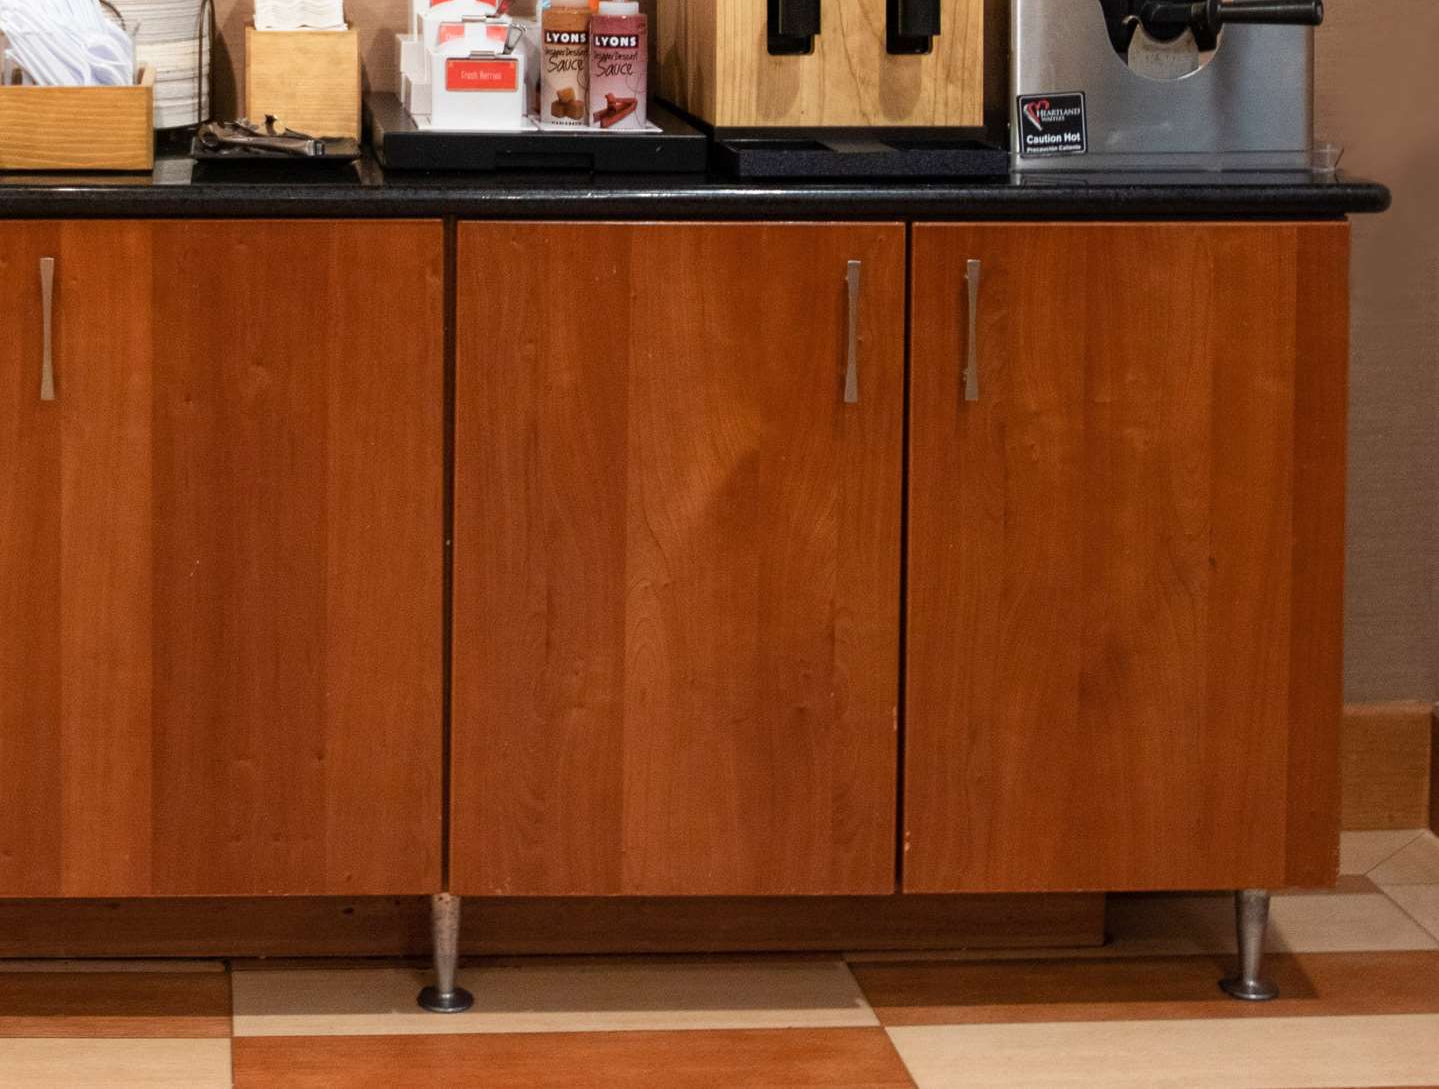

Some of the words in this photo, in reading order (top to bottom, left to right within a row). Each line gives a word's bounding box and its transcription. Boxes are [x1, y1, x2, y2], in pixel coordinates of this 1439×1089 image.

[546, 32, 587, 43] LYONS
[595, 36, 637, 47] LYONS
[547, 55, 584, 73] Sauce
[596, 60, 634, 77] Sauce
[1026, 133, 1062, 144] Caution
[1064, 131, 1081, 142] Hot
